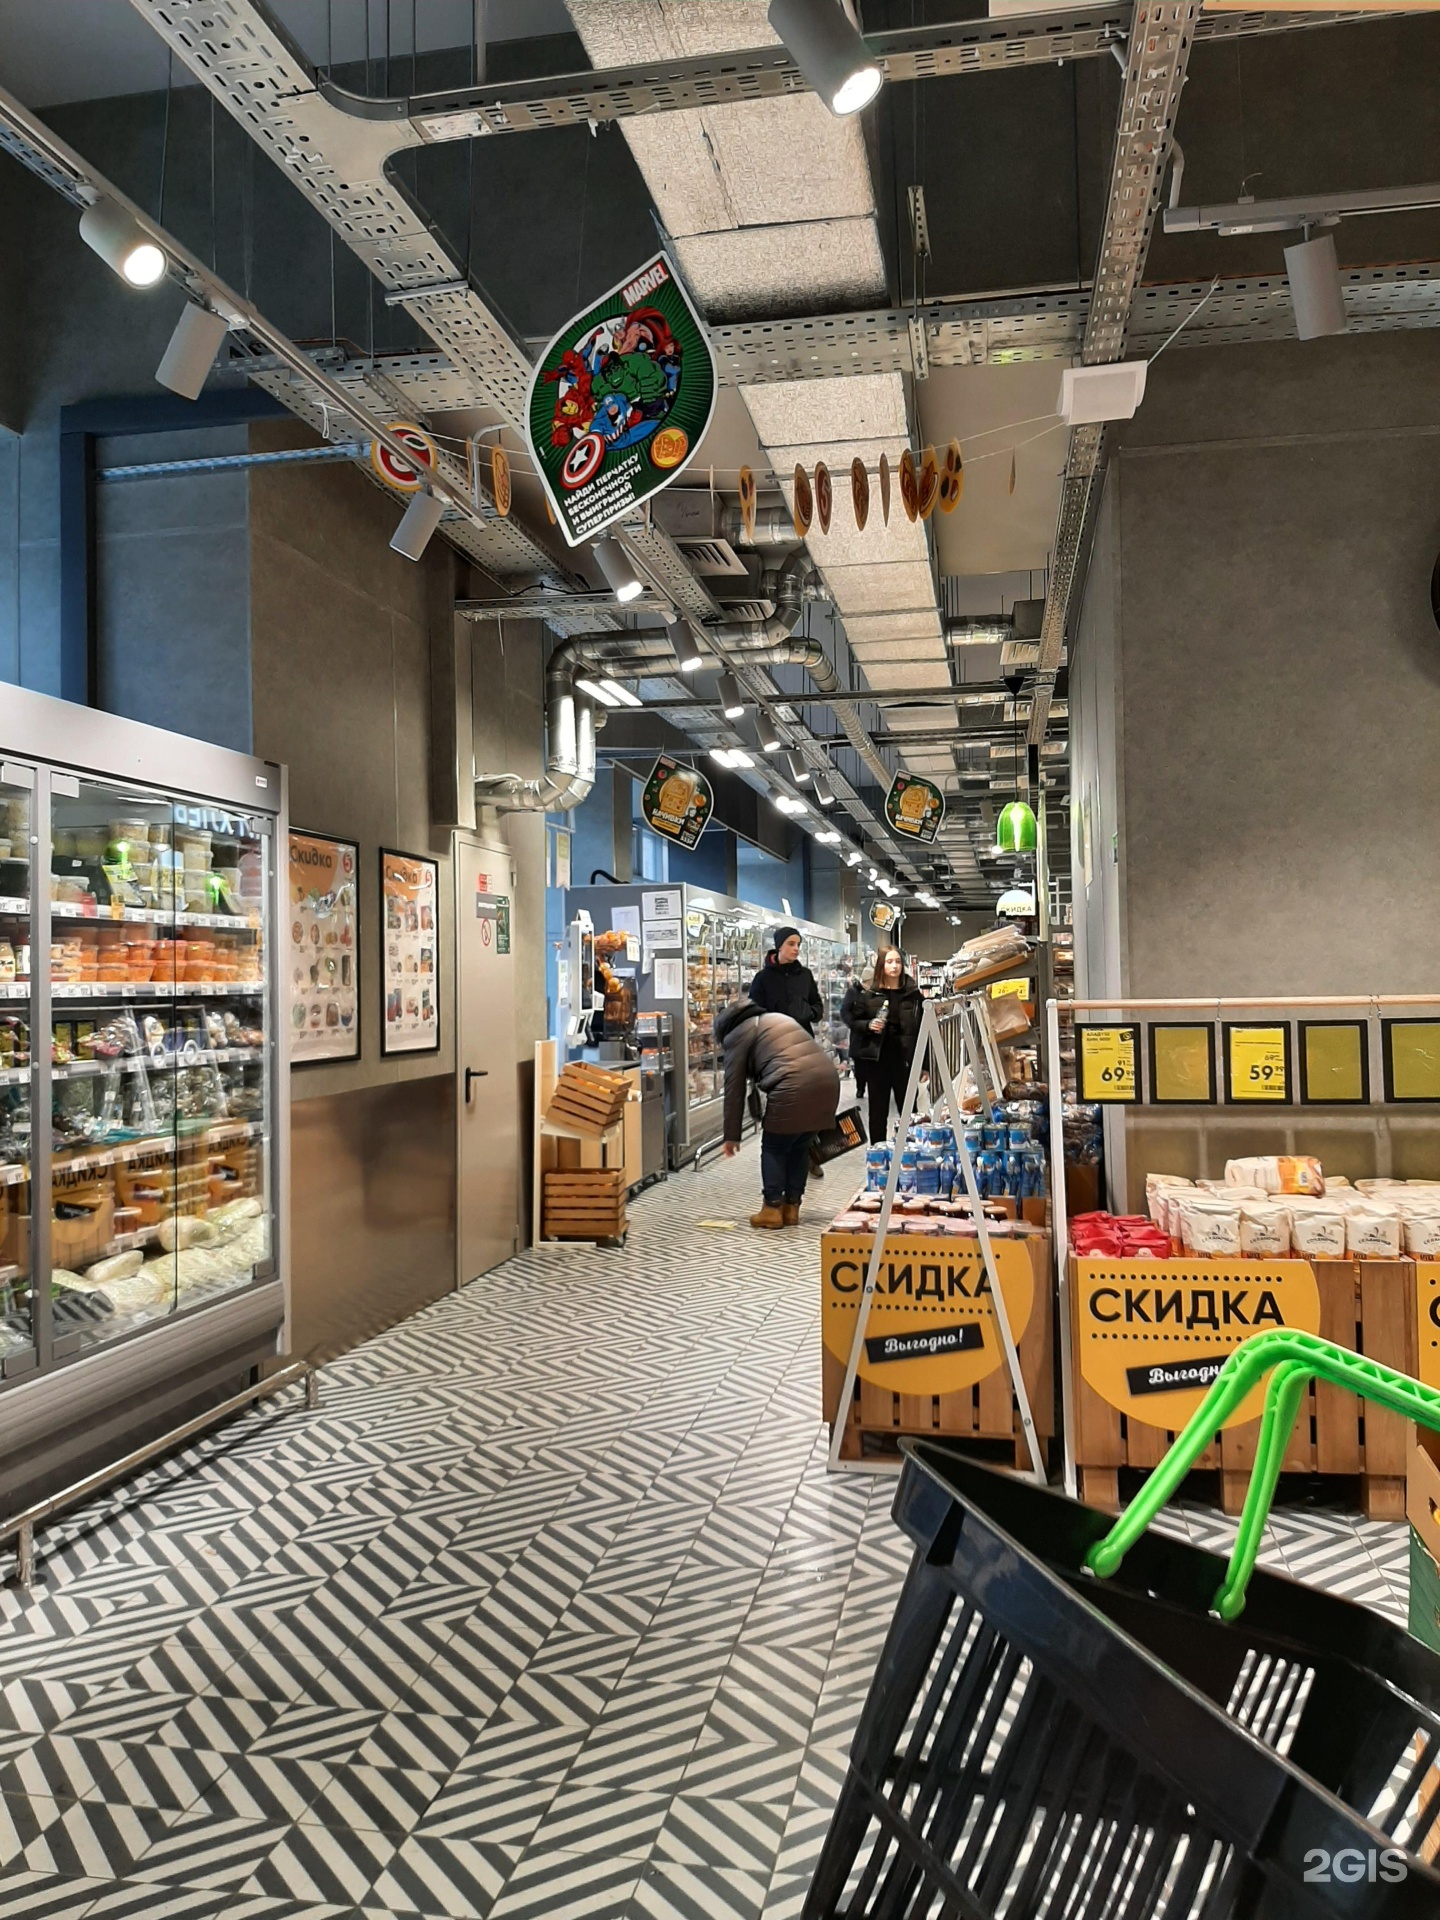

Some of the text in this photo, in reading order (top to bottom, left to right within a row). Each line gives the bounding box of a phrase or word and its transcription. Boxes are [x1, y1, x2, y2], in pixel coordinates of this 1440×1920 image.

[622, 262, 669, 307] MARVEL
[563, 452, 639, 507] НАЙДИ ПЕРЧАТКУ
[567, 463, 642, 517] БЕСКОНЕЧНОСТИ
[571, 481, 632, 526] И ВЫИГРЫВАЙ
[575, 492, 636, 534] СУПЕРПРИЗЫ!
[290, 845, 332, 868] Скидка
[1101, 1066, 1125, 1082] 69
[1249, 1064, 1274, 1081] 59
[830, 1261, 993, 1302] СКИДКА
[1089, 1287, 1286, 1331] СКИДКА
[884, 1327, 964, 1353] Выгодно!
[1148, 1364, 1225, 1387] Выгодн
